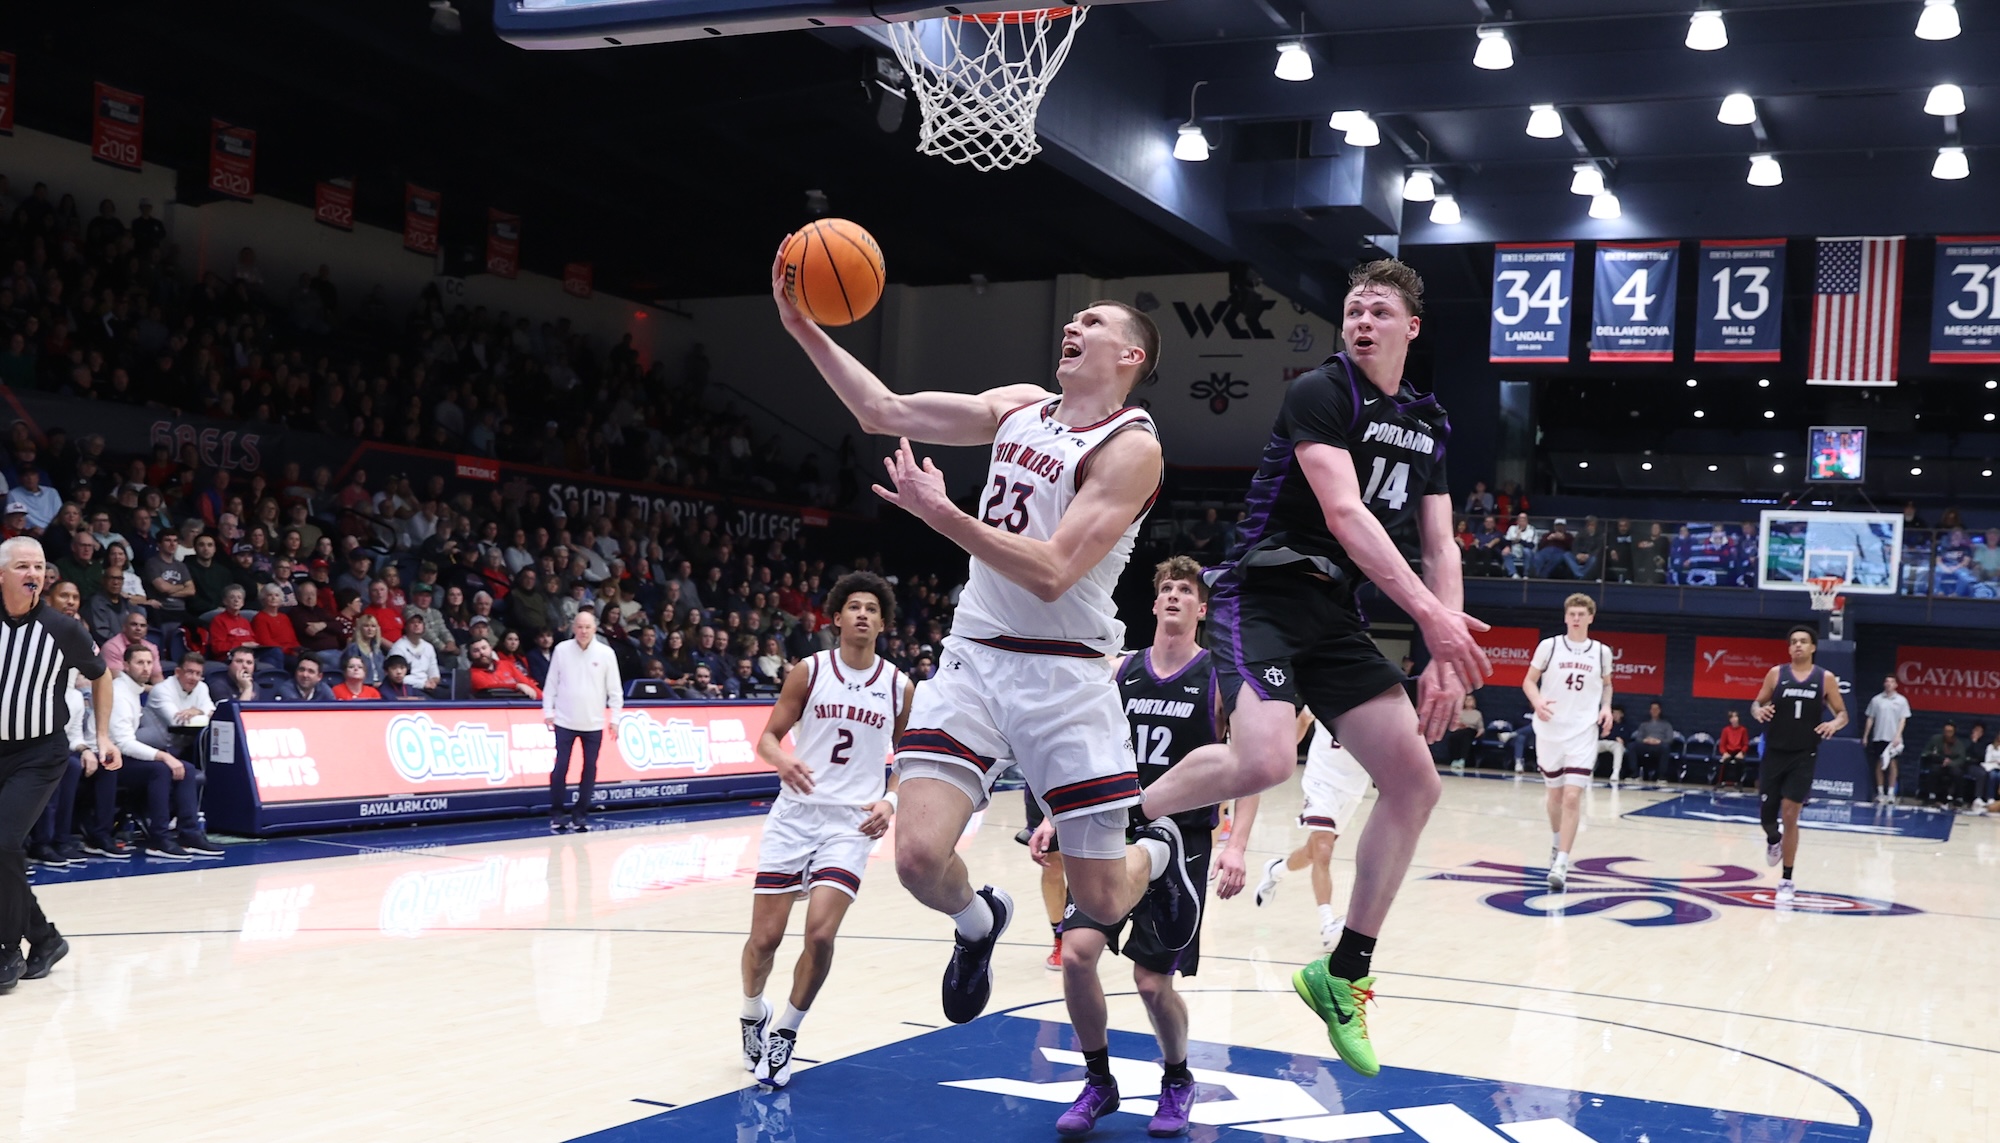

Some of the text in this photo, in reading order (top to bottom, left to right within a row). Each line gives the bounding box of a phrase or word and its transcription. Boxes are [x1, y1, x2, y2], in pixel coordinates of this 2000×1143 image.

[99, 136, 139, 163] 2019
[212, 167, 250, 195] 2020
[1493, 269, 1570, 325] 34
[1611, 268, 1657, 321] 4
[1712, 266, 1771, 320] 13
[1947, 263, 2000, 320] 31
[1172, 300, 1277, 339] WCC
[1595, 326, 1670, 337] DELLAVEDOVA
[1721, 325, 1756, 336] MILLS
[1505, 331, 1555, 342] LANDALE
[150, 420, 261, 472] GAELS
[1361, 421, 1435, 455] PORTLAND
[457, 465, 497, 481] SECTION C
[1017, 445, 1064, 484] MARY'S
[1361, 456, 1411, 510] 14
[982, 474, 1034, 534] 23
[1565, 672, 1585, 691] 45
[1897, 660, 2000, 690] CAYMUS
[1124, 698, 1195, 718] PORTLAND
[1794, 700, 1803, 719] 1
[1904, 687, 1996, 700] VINEYARDS
[814, 703, 886, 729] SAINT MARY'S
[394, 719, 508, 778] O'Reilly
[621, 715, 706, 769] O'Reilly
[829, 728, 854, 765] 2
[1136, 724, 1173, 766] 12
[360, 798, 448, 816] BAYALARM.COM
[609, 788, 634, 800] YOUR
[635, 786, 659, 797] HOME
[660, 784, 689, 796] COURT
